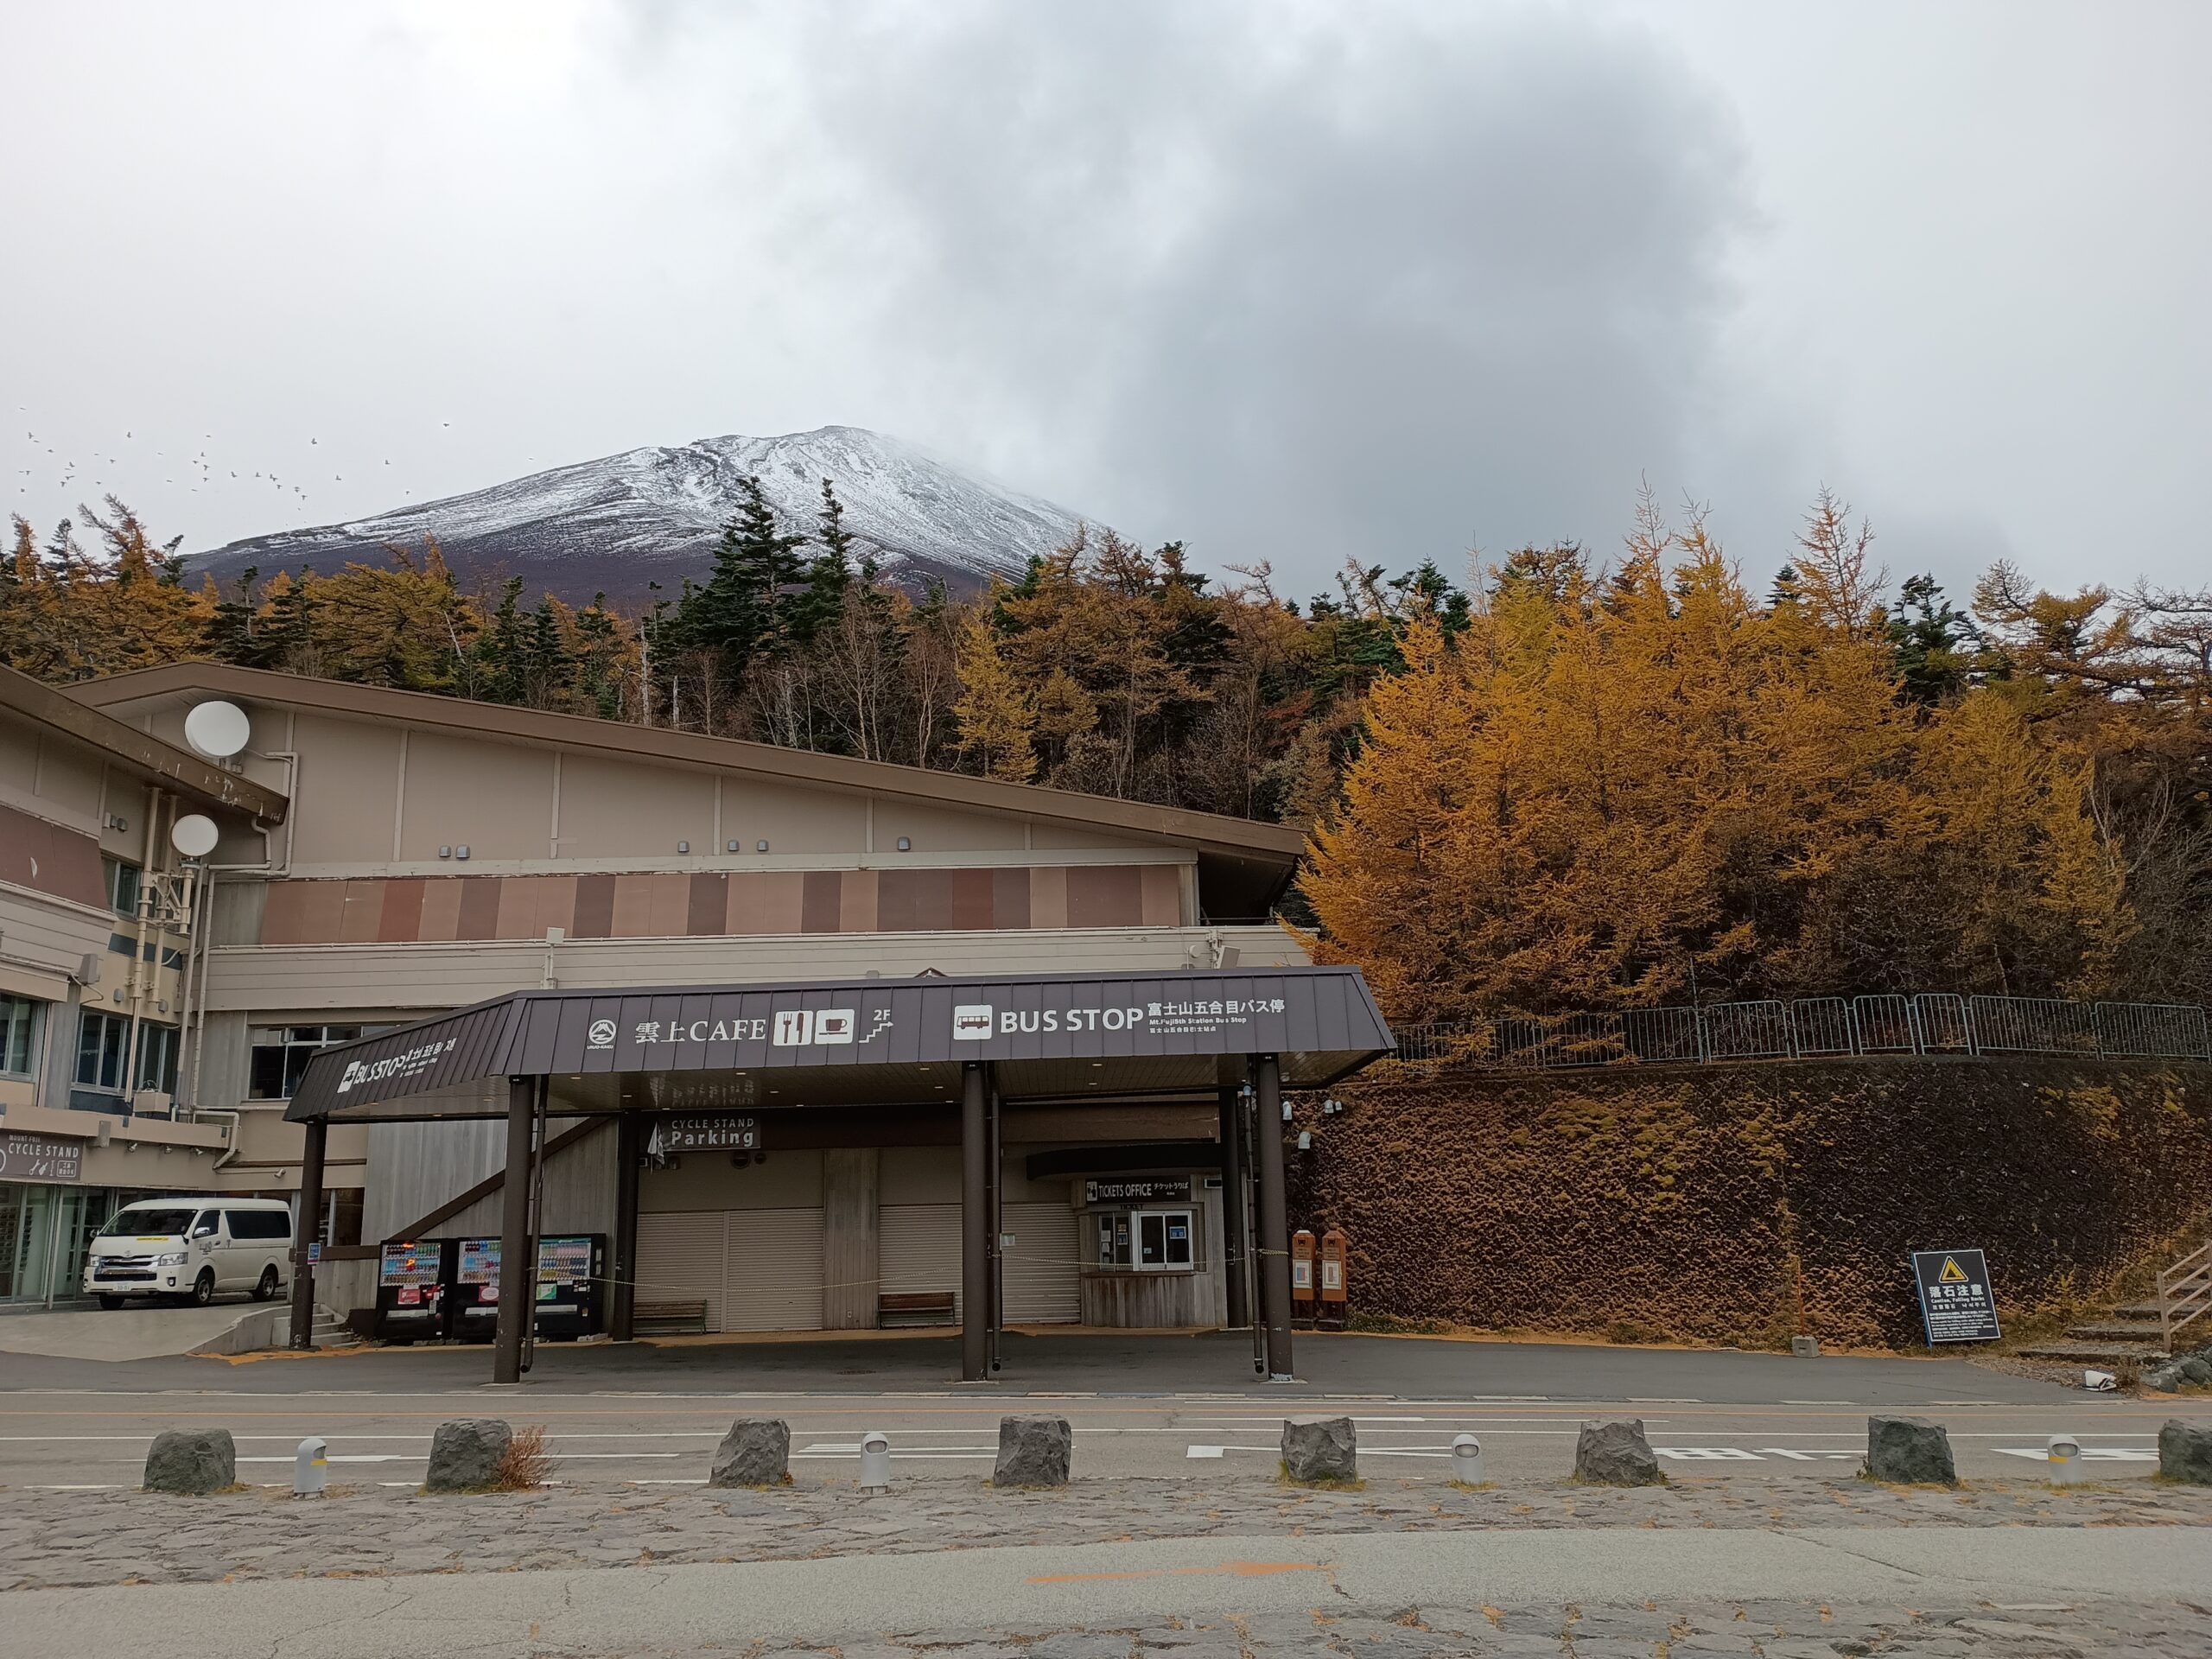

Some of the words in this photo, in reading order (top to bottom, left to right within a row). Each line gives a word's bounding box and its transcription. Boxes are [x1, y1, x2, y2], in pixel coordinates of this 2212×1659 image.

[873, 1008, 891, 1021] 2F
[1147, 998, 1286, 1017] 富士山五合目バス停
[1000, 1009, 1059, 1033] BUS
[1065, 1007, 1145, 1032] STOP
[1215, 1016, 1230, 1025] Bus
[1230, 1015, 1247, 1025] Stop
[353, 1062, 380, 1085] BUS
[671, 1119, 709, 1129] CYCLE
[714, 1117, 754, 1128] STAND
[671, 1128, 754, 1147] Parking
[8, 1142, 41, 1155] CYCLE
[46, 1145, 79, 1158] STAND
[1098, 1184, 1124, 1198] TICKETS
[1124, 1183, 1153, 1197] OFFICE
[1929, 1283, 1984, 1298] 落石注意
